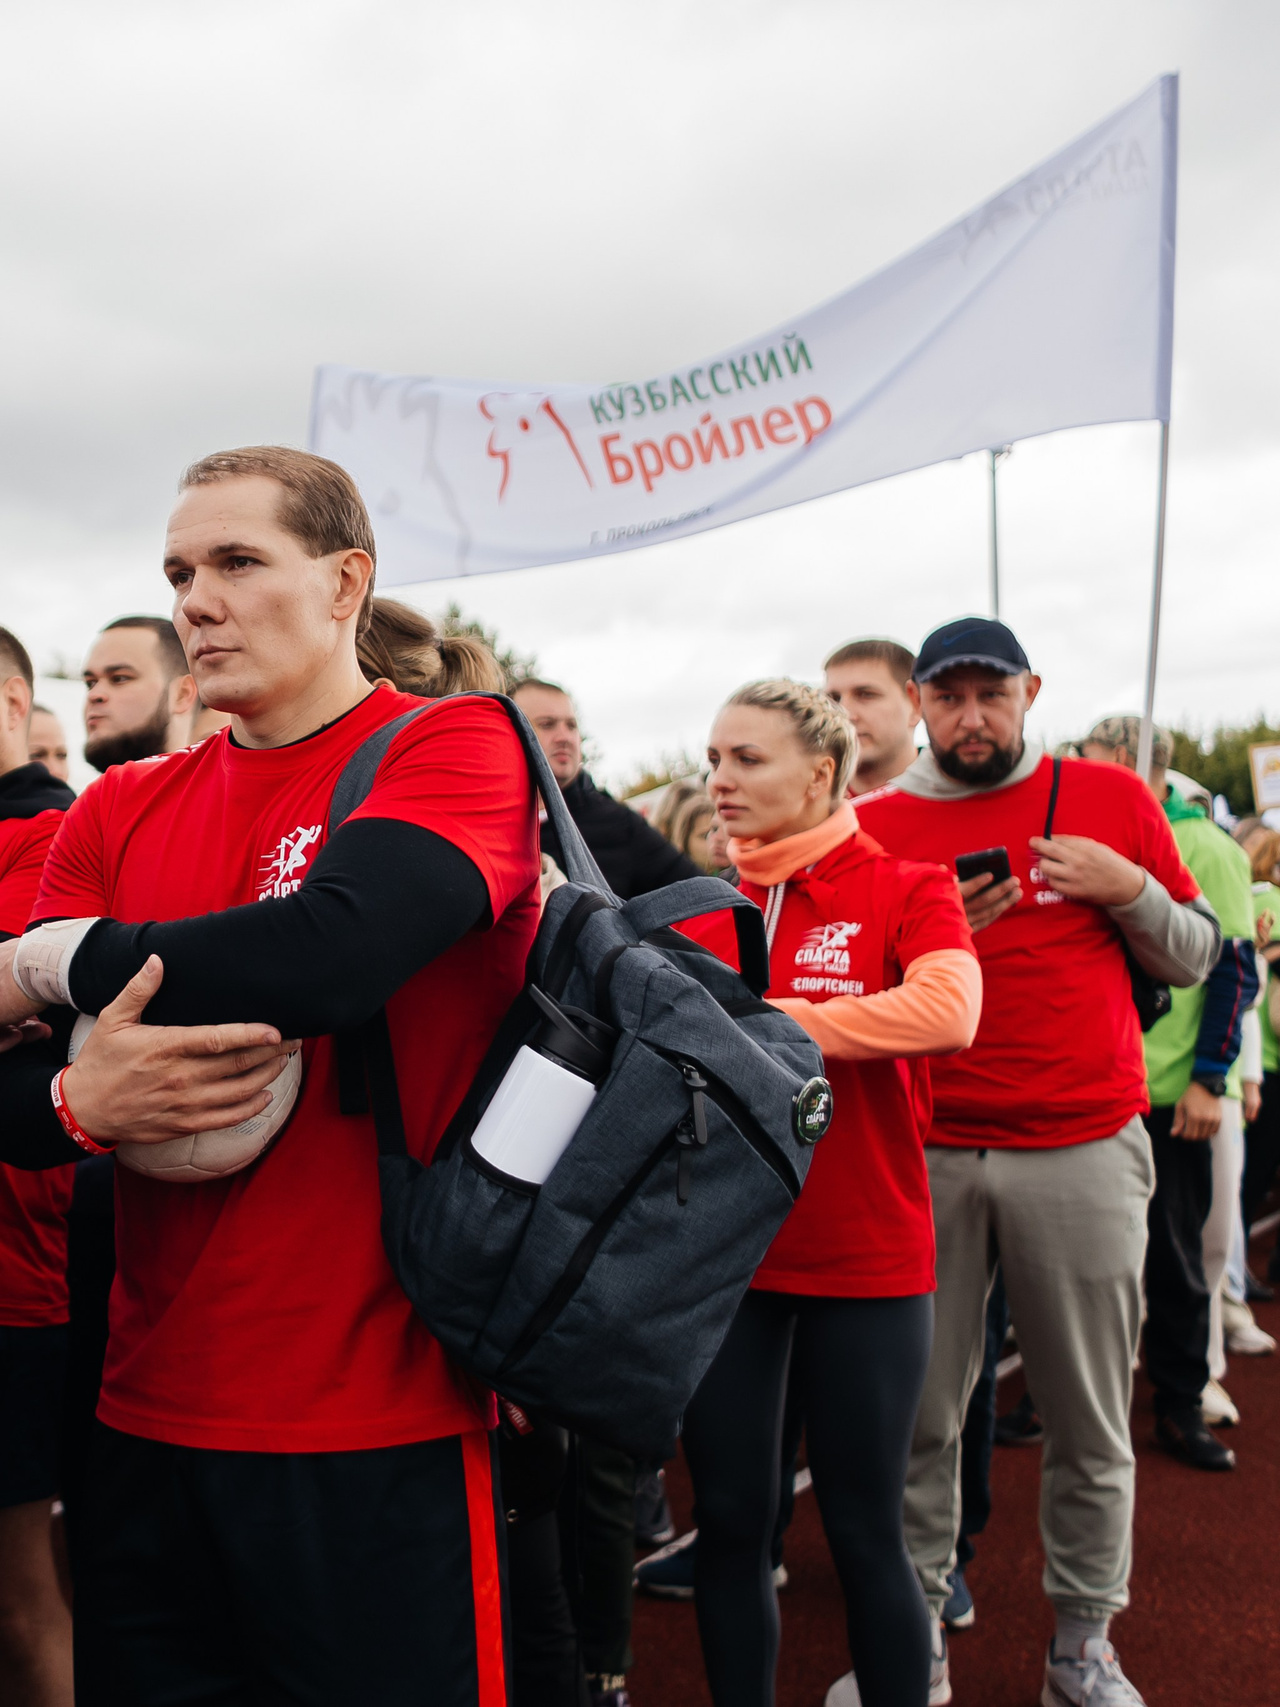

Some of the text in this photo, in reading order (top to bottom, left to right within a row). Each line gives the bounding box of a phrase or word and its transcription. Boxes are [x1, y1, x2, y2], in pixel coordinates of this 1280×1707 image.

[588, 331, 814, 424] КУЗБАССКИЙ
[600, 395, 833, 493] Бройлер
[258, 879, 302, 901] СПАРТ
[794, 947, 851, 966] СПАРТА
[792, 976, 864, 995] СПОРТСМЕН
